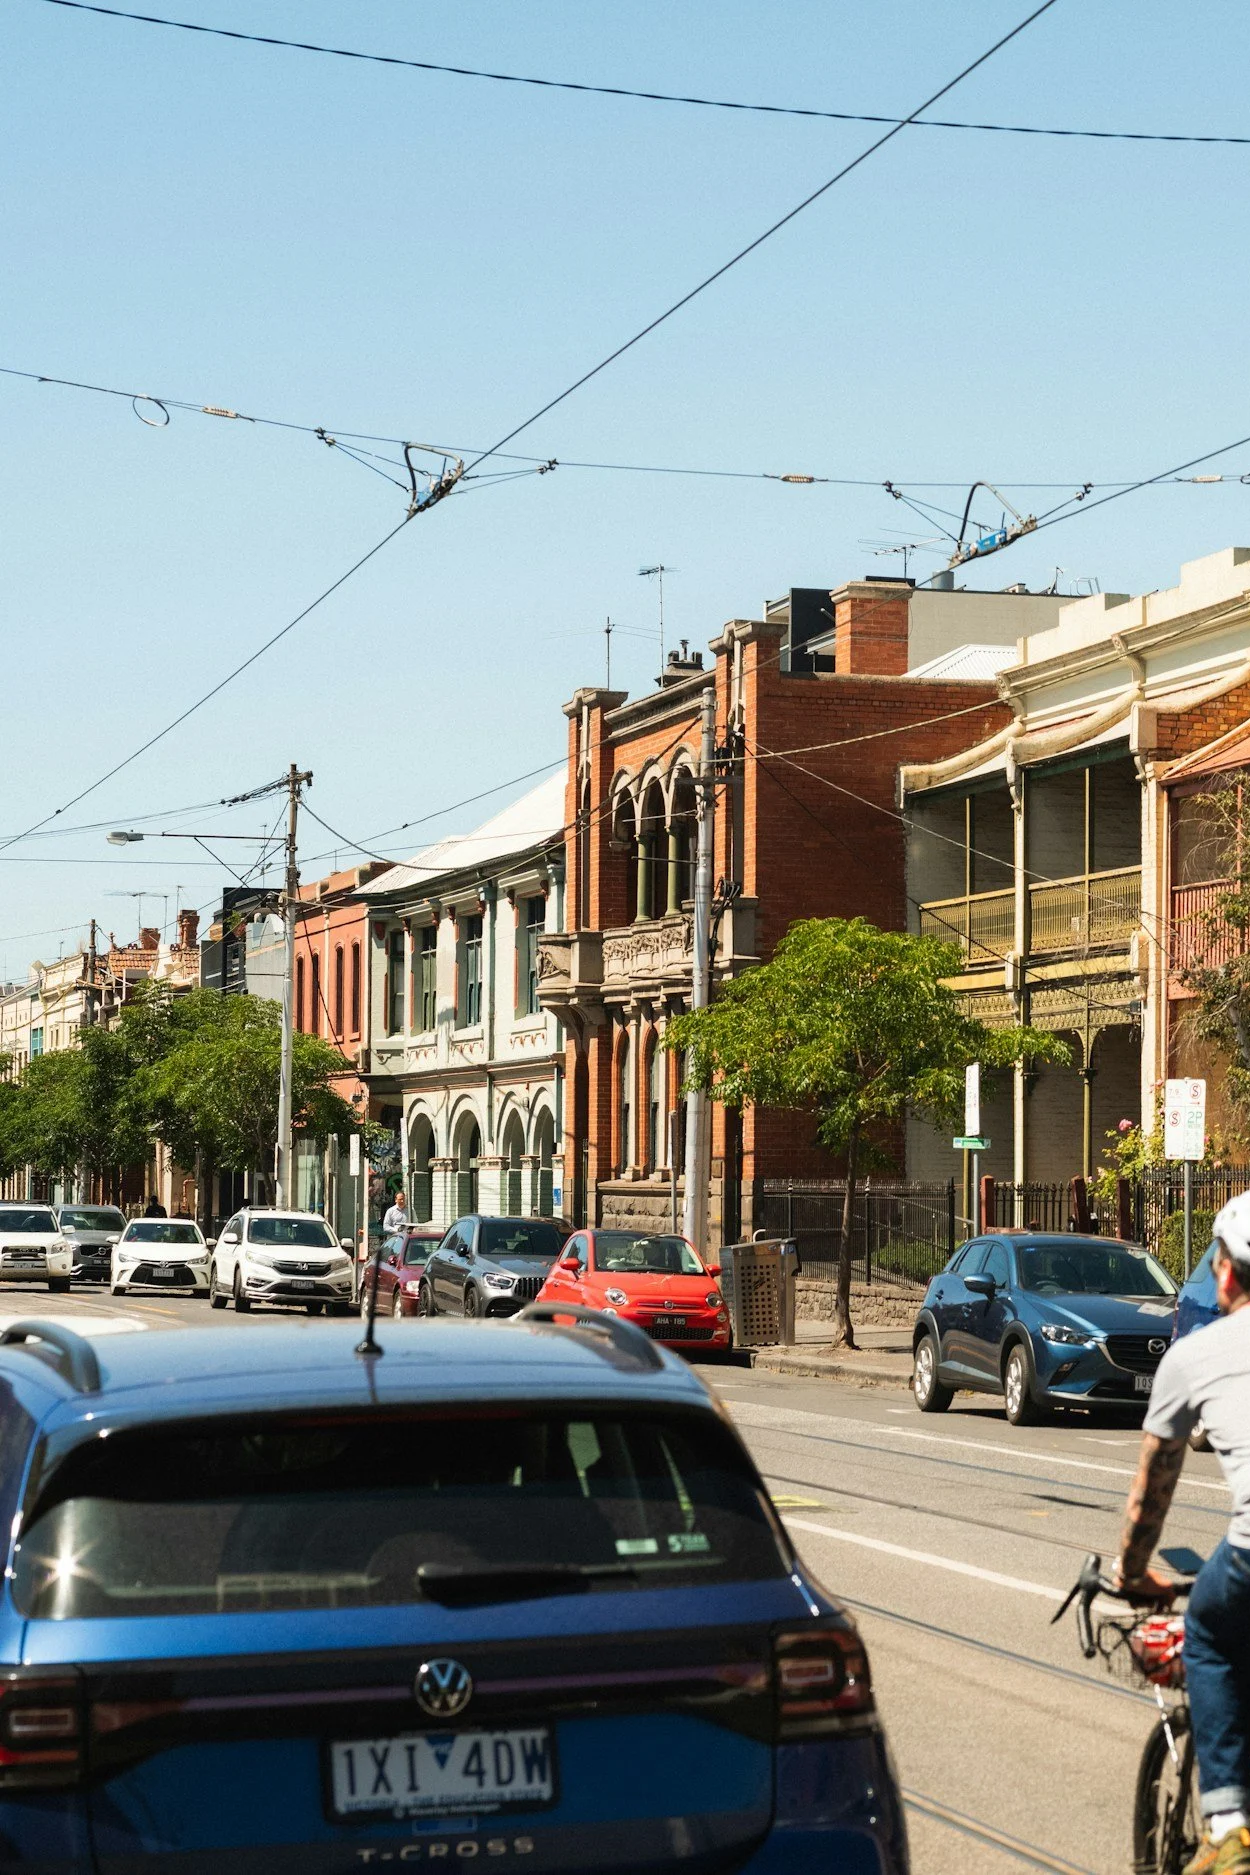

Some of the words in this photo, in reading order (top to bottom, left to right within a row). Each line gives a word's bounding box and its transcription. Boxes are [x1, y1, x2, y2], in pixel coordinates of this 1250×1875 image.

[343, 1745, 420, 1796] 1XI
[463, 1738, 549, 1787] 4DW
[357, 1836, 535, 1863] T-CROSS
